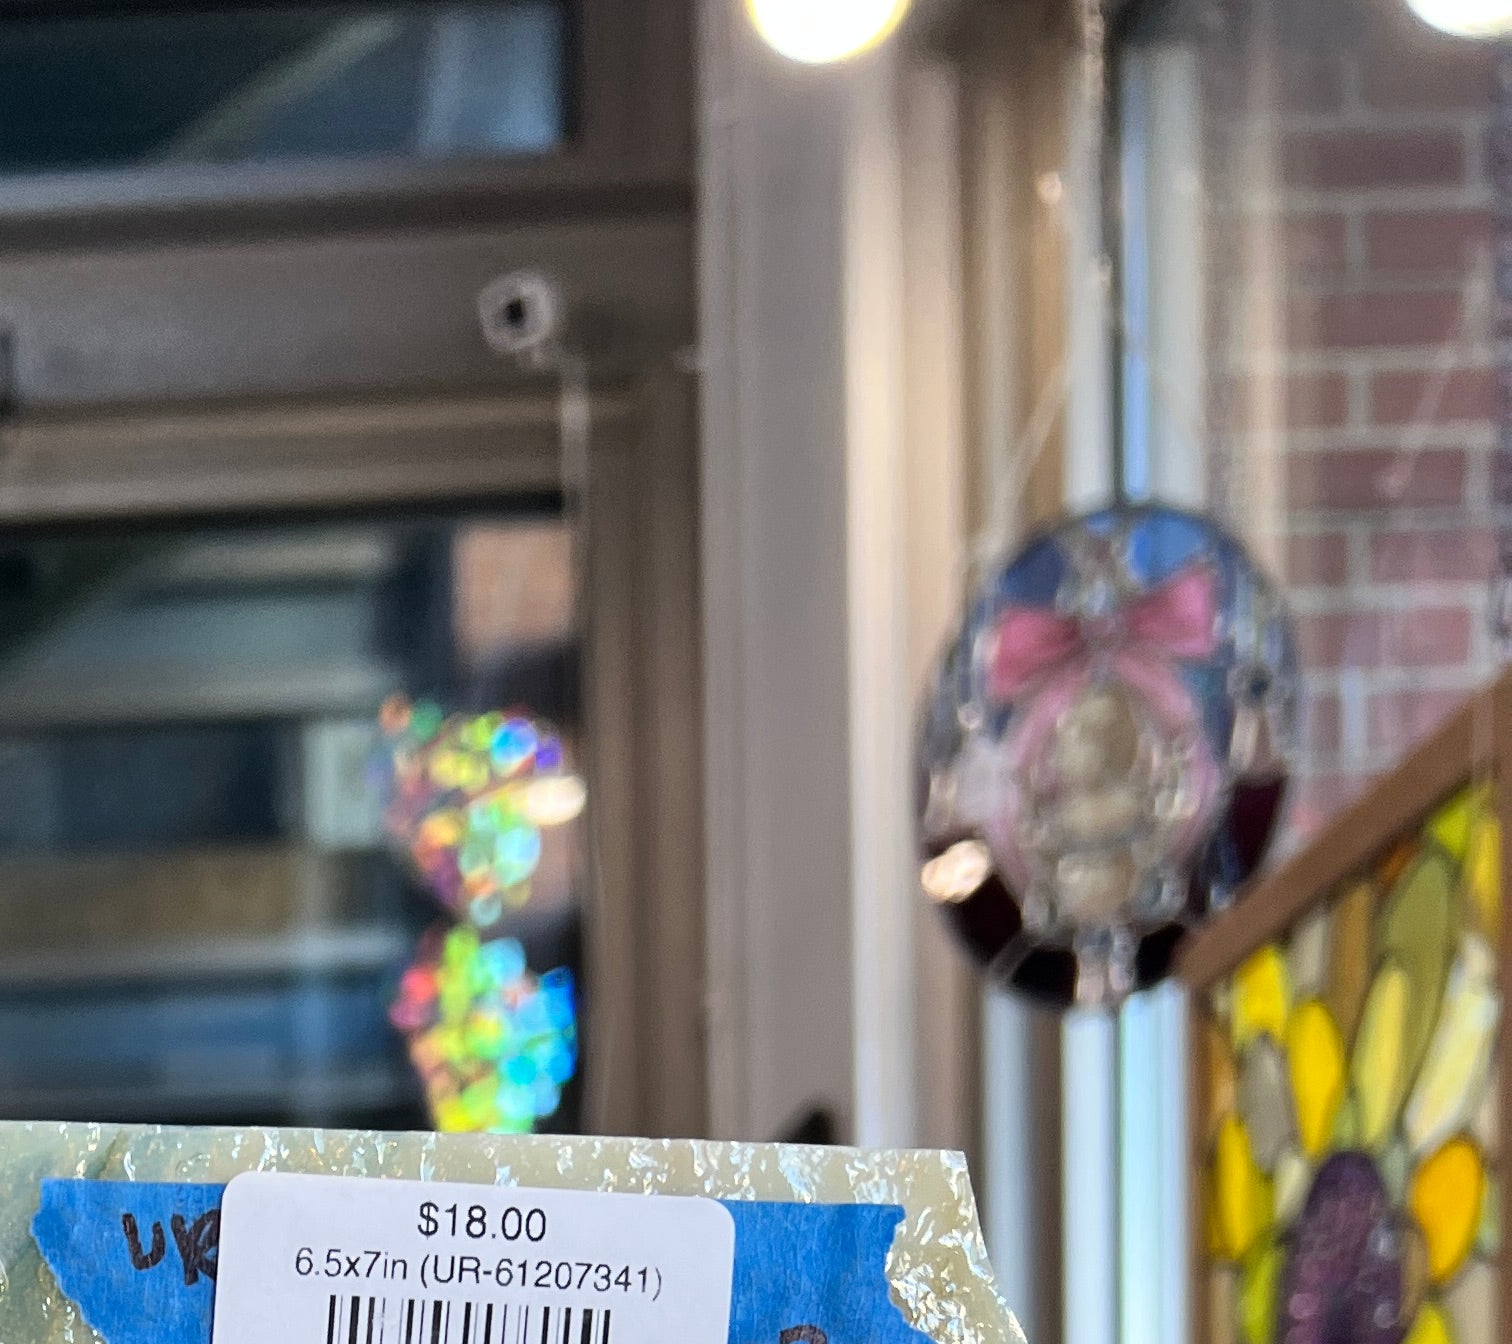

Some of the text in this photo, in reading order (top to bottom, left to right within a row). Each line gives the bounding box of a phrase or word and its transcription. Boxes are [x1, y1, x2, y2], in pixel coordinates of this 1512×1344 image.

[417, 1200, 548, 1241] $18.00
[294, 1246, 663, 1302] 6.5x7in (UR-61207341)
